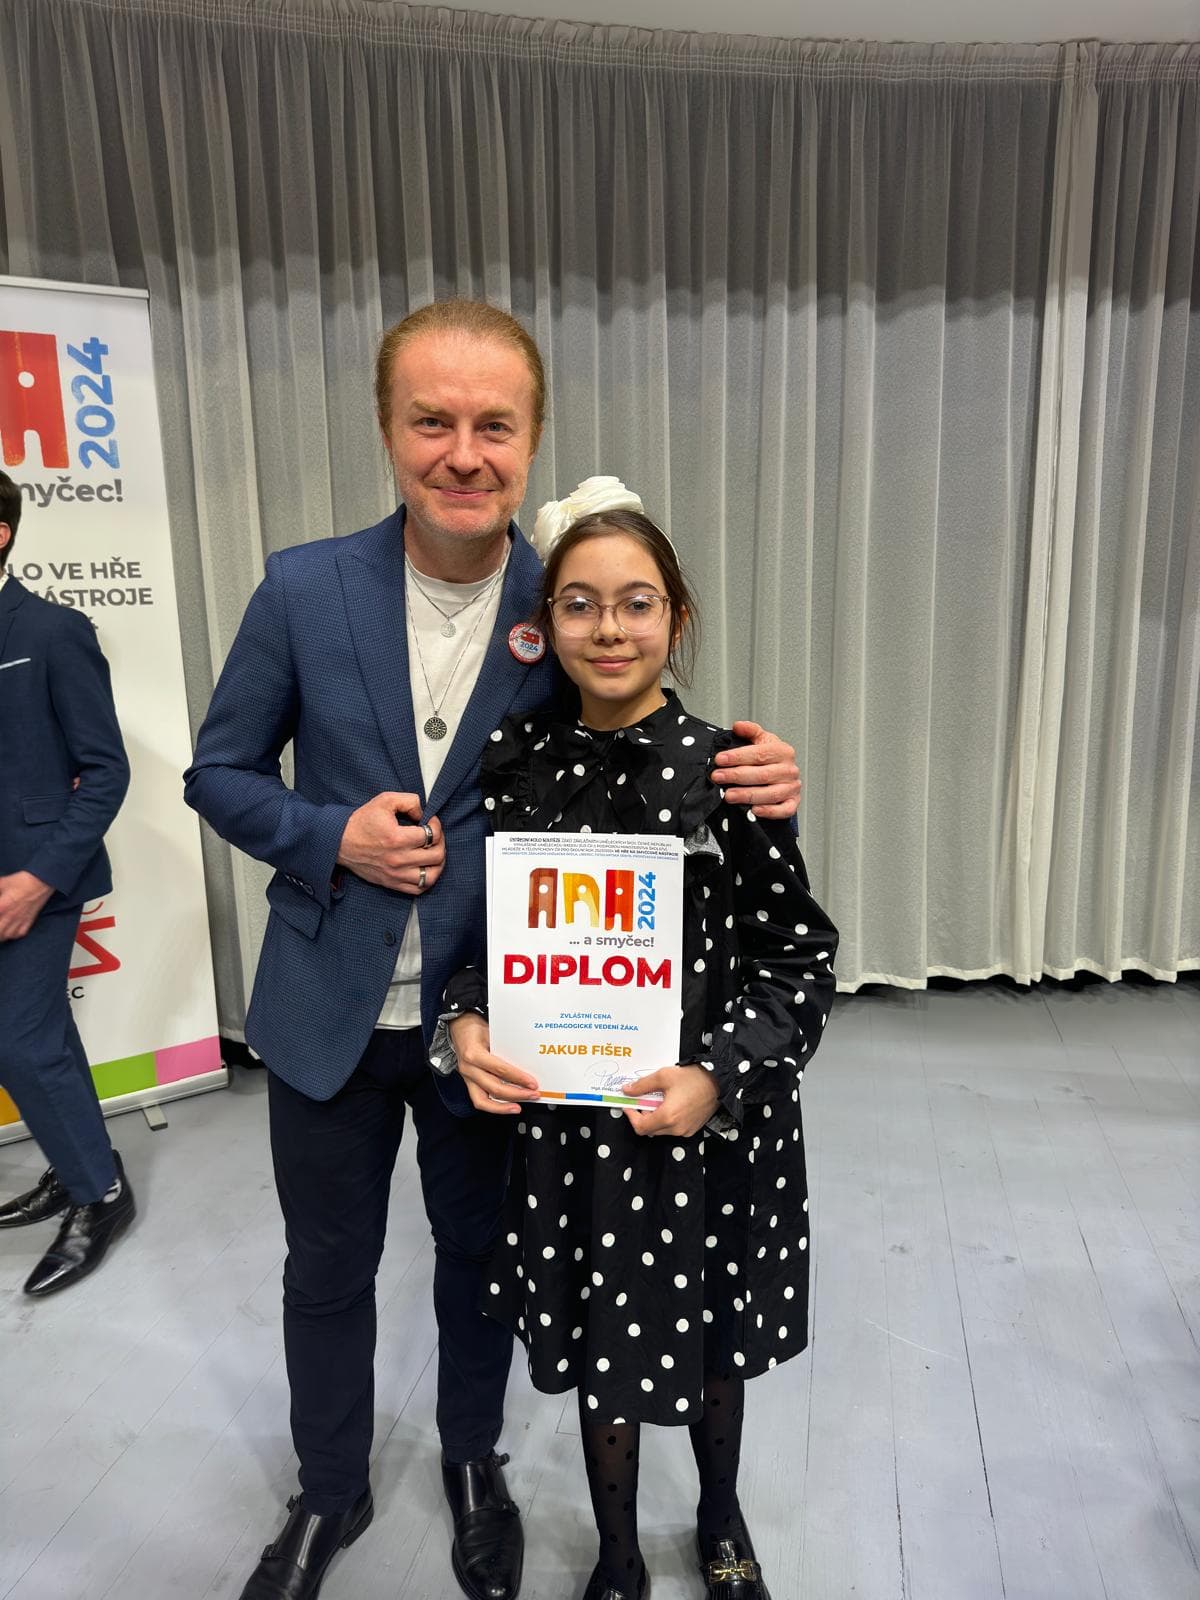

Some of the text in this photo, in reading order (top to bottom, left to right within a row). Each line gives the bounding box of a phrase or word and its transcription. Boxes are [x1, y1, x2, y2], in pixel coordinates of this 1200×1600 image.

[67, 337, 120, 469] 2024
[48, 562, 84, 580] VE
[91, 557, 143, 579] HŘE
[34, 586, 154, 608] ÁSTROJE
[637, 871, 656, 930] 2024
[584, 936, 592, 945] a
[596, 935, 654, 949] smyčec!
[503, 954, 672, 988] DIPLOM
[539, 1042, 632, 1057] JAKUB FIŠER
